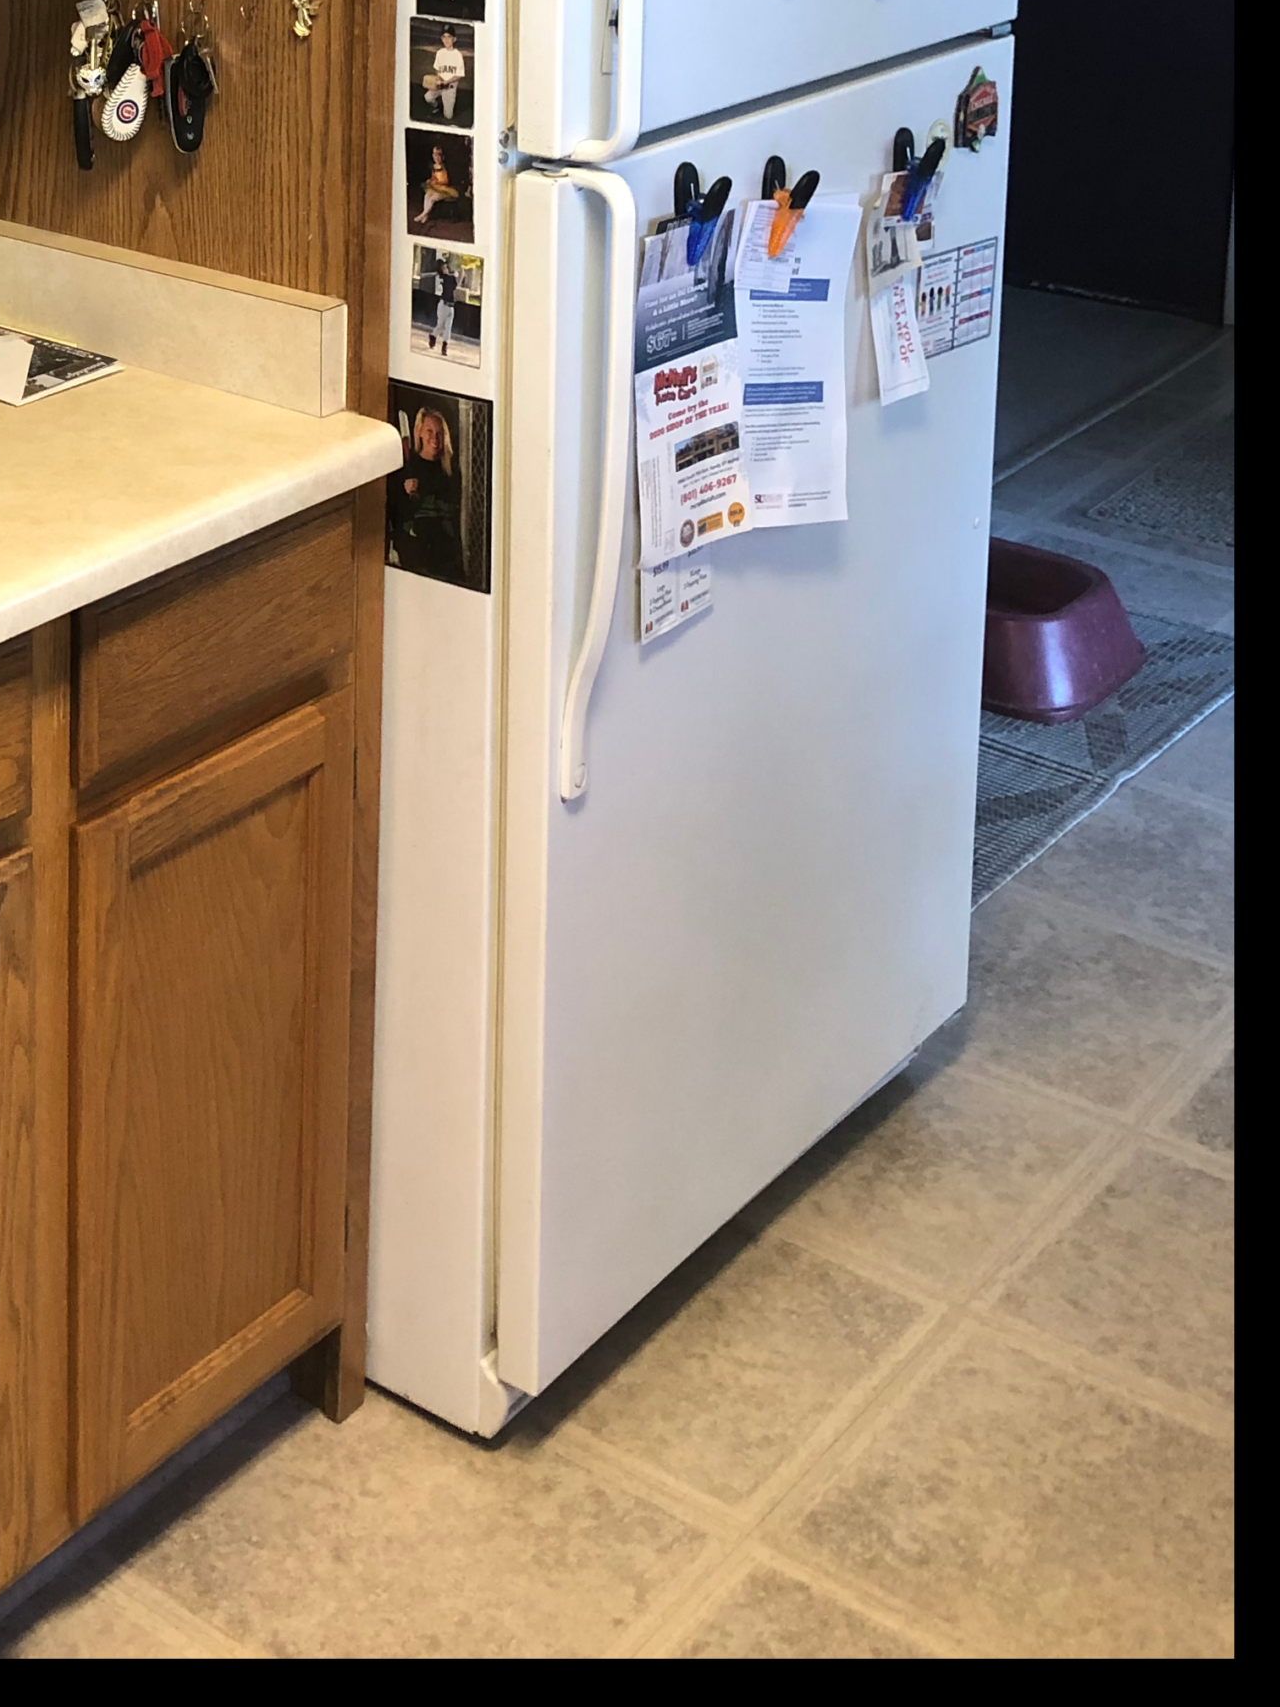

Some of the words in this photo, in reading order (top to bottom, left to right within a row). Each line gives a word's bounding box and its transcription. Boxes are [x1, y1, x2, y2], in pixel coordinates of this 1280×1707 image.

[900, 320, 915, 354] YOU
[899, 345, 910, 364] OF
[666, 420, 684, 433] SHOP
[685, 416, 694, 425] OF
[695, 409, 707, 421] THE
[708, 402, 729, 415] YEAR!
[668, 409, 686, 420] Come
[687, 404, 697, 413] try
[698, 399, 709, 409] the
